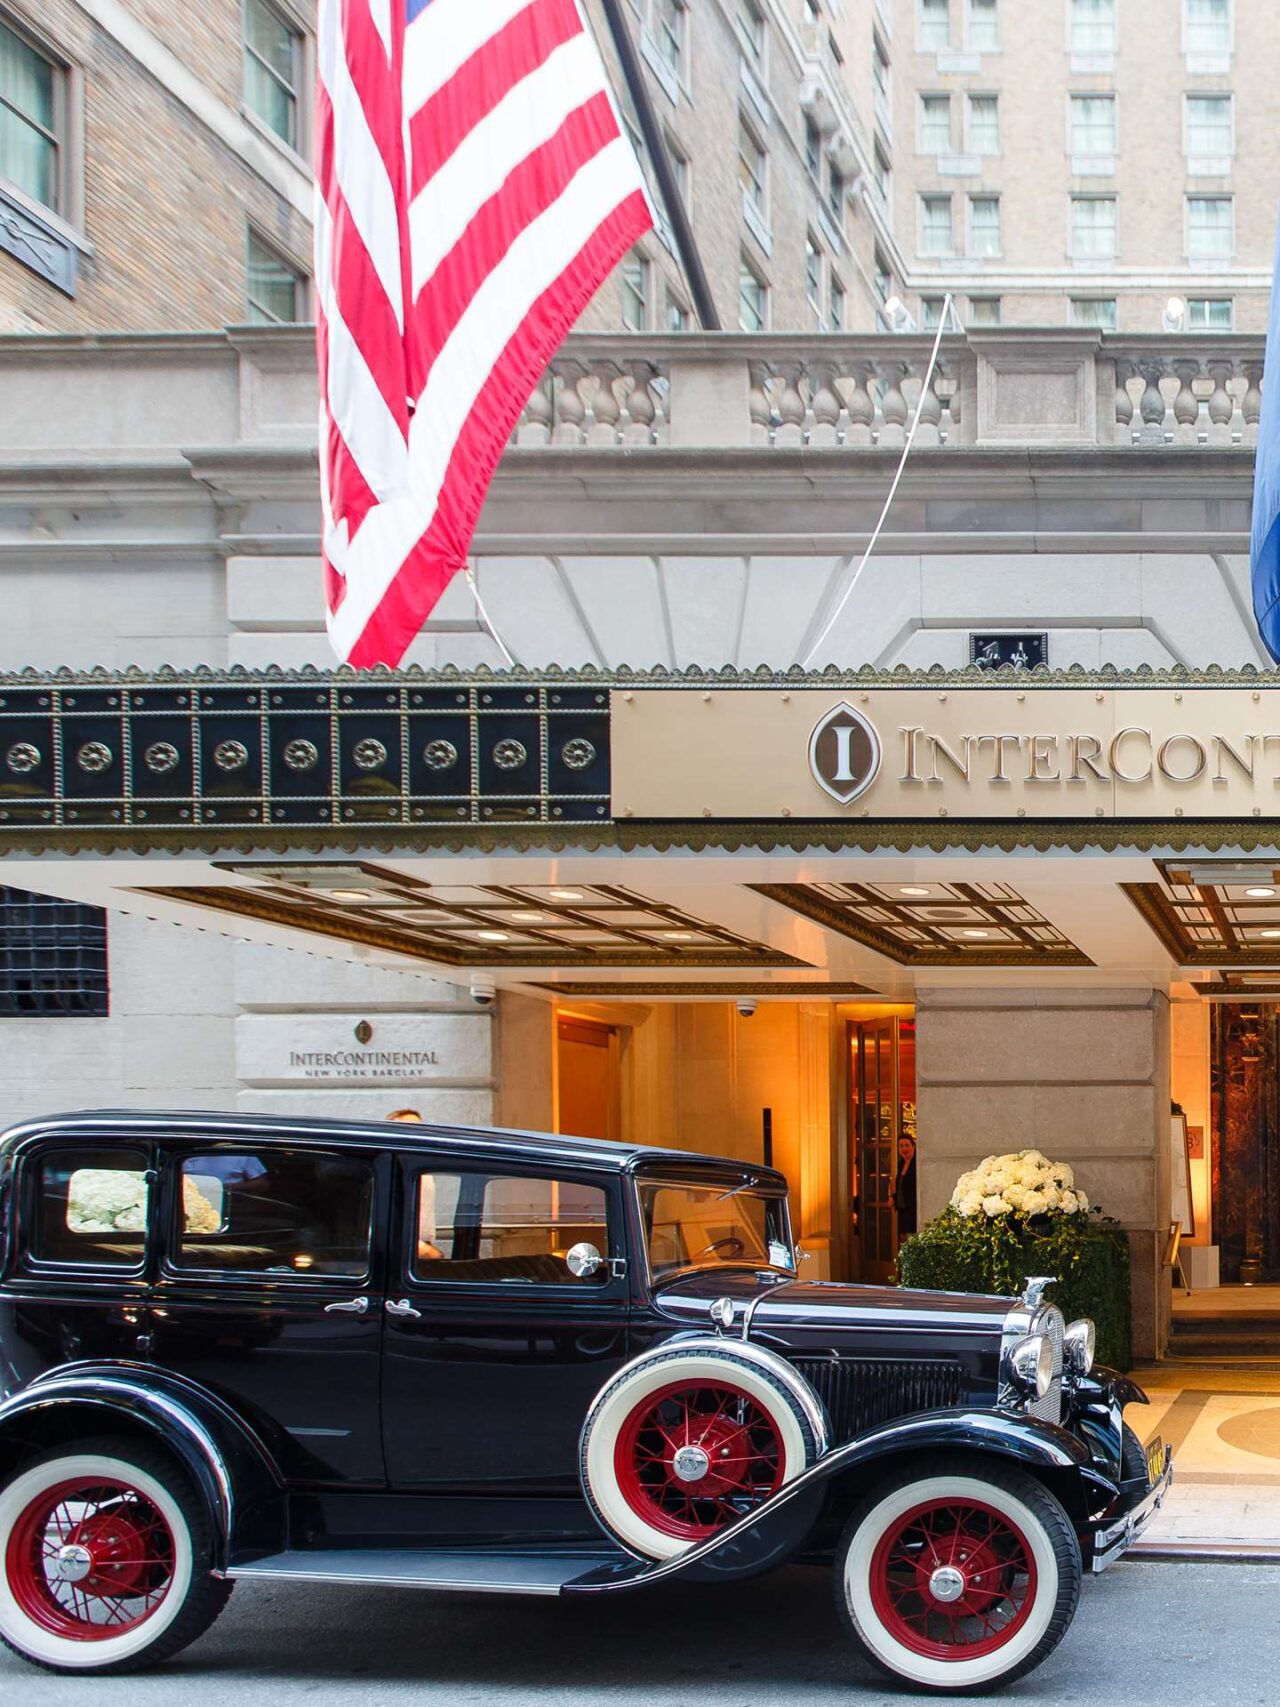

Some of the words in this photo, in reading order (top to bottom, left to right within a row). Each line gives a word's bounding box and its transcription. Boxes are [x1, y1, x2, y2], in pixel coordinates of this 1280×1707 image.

[290, 1051, 439, 1066] INTERCONTINENTAL
[305, 1069, 330, 1077] NEW
[337, 1069, 366, 1077] YORK
[372, 1069, 424, 1077] BARCLAY
